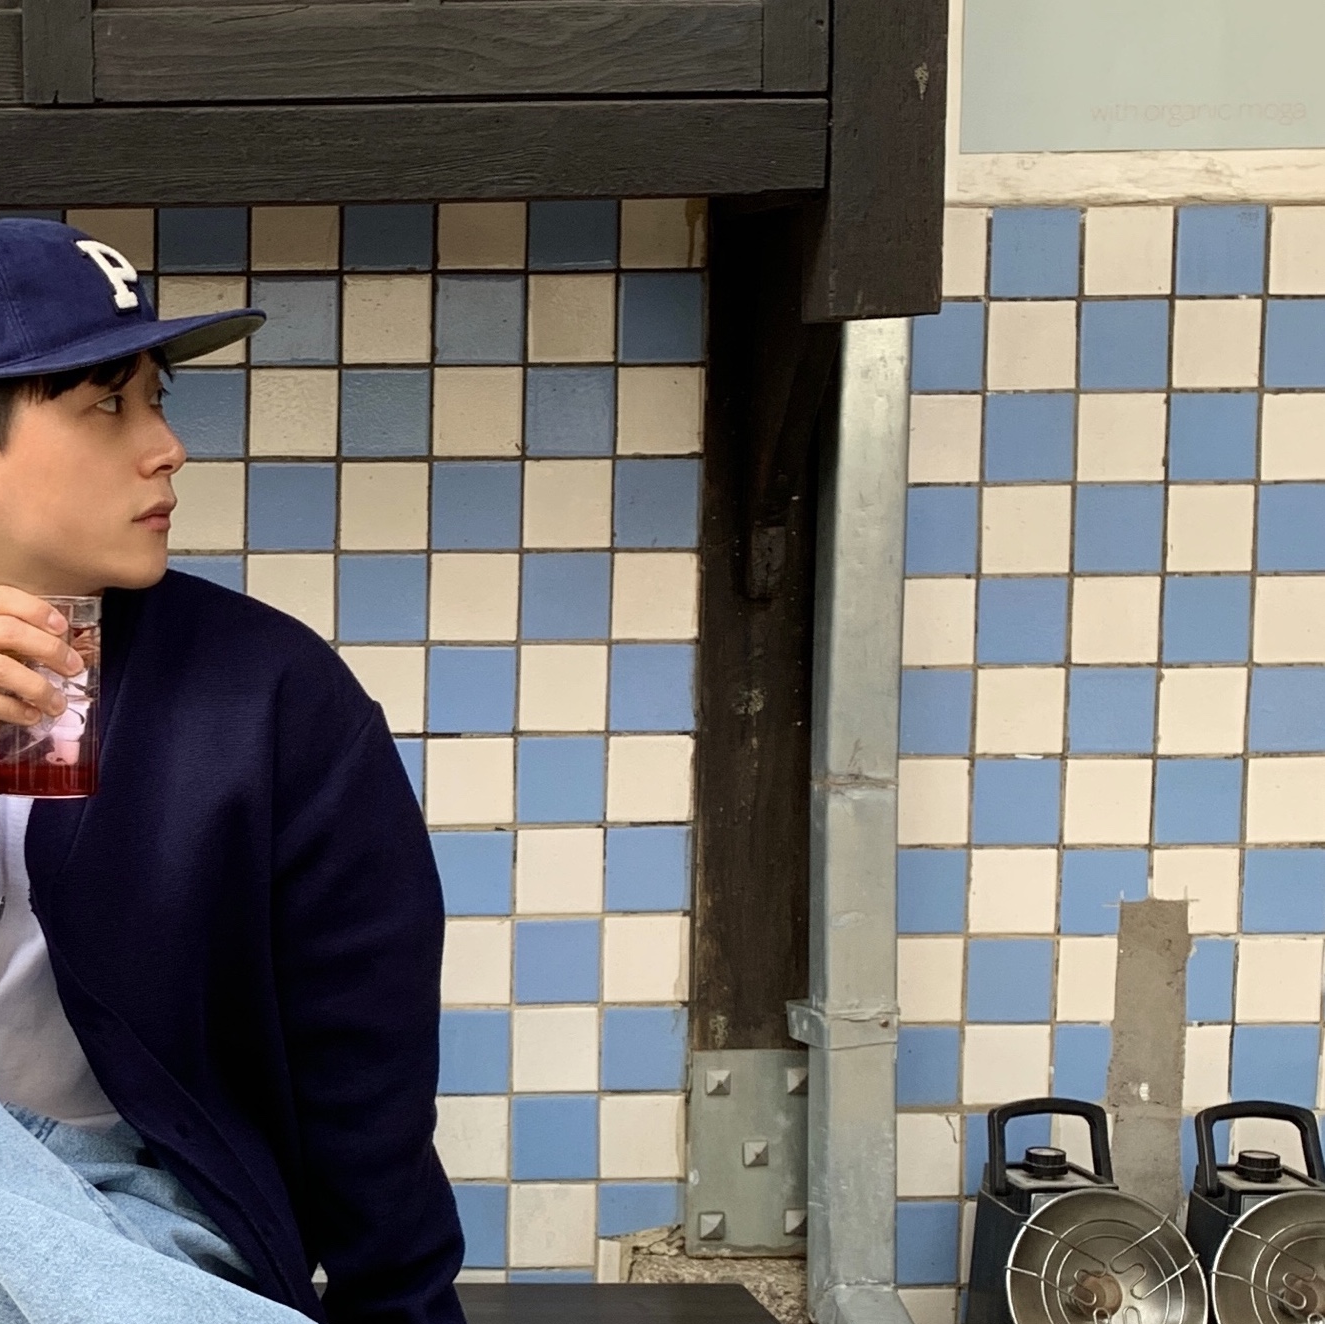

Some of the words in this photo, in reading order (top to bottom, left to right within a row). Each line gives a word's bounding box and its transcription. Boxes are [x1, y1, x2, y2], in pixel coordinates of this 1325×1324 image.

[1090, 99, 1138, 121] with
[1144, 102, 1232, 127] organic
[76, 240, 138, 309] P
